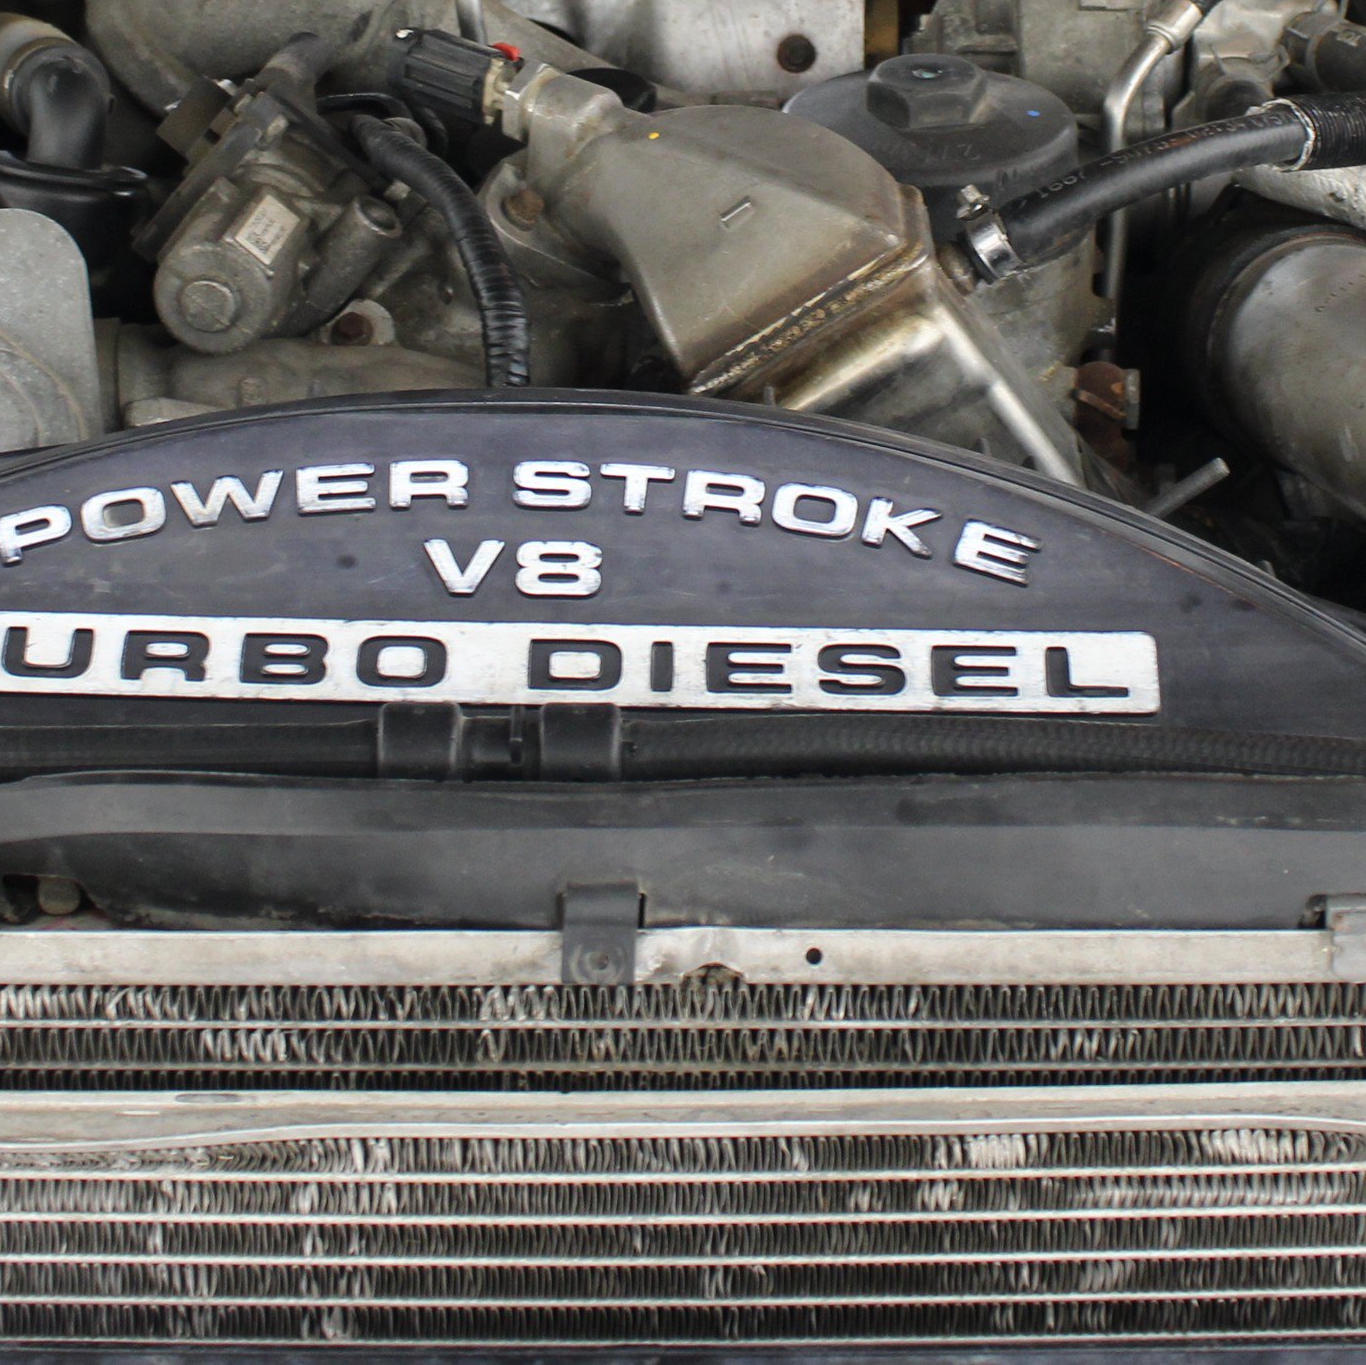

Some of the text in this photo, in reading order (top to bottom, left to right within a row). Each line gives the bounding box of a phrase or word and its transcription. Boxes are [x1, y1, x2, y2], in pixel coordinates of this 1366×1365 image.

[511, 460, 1043, 586] STROKE
[422, 538, 604, 598] V8
[526, 637, 1131, 699] DIESEL
